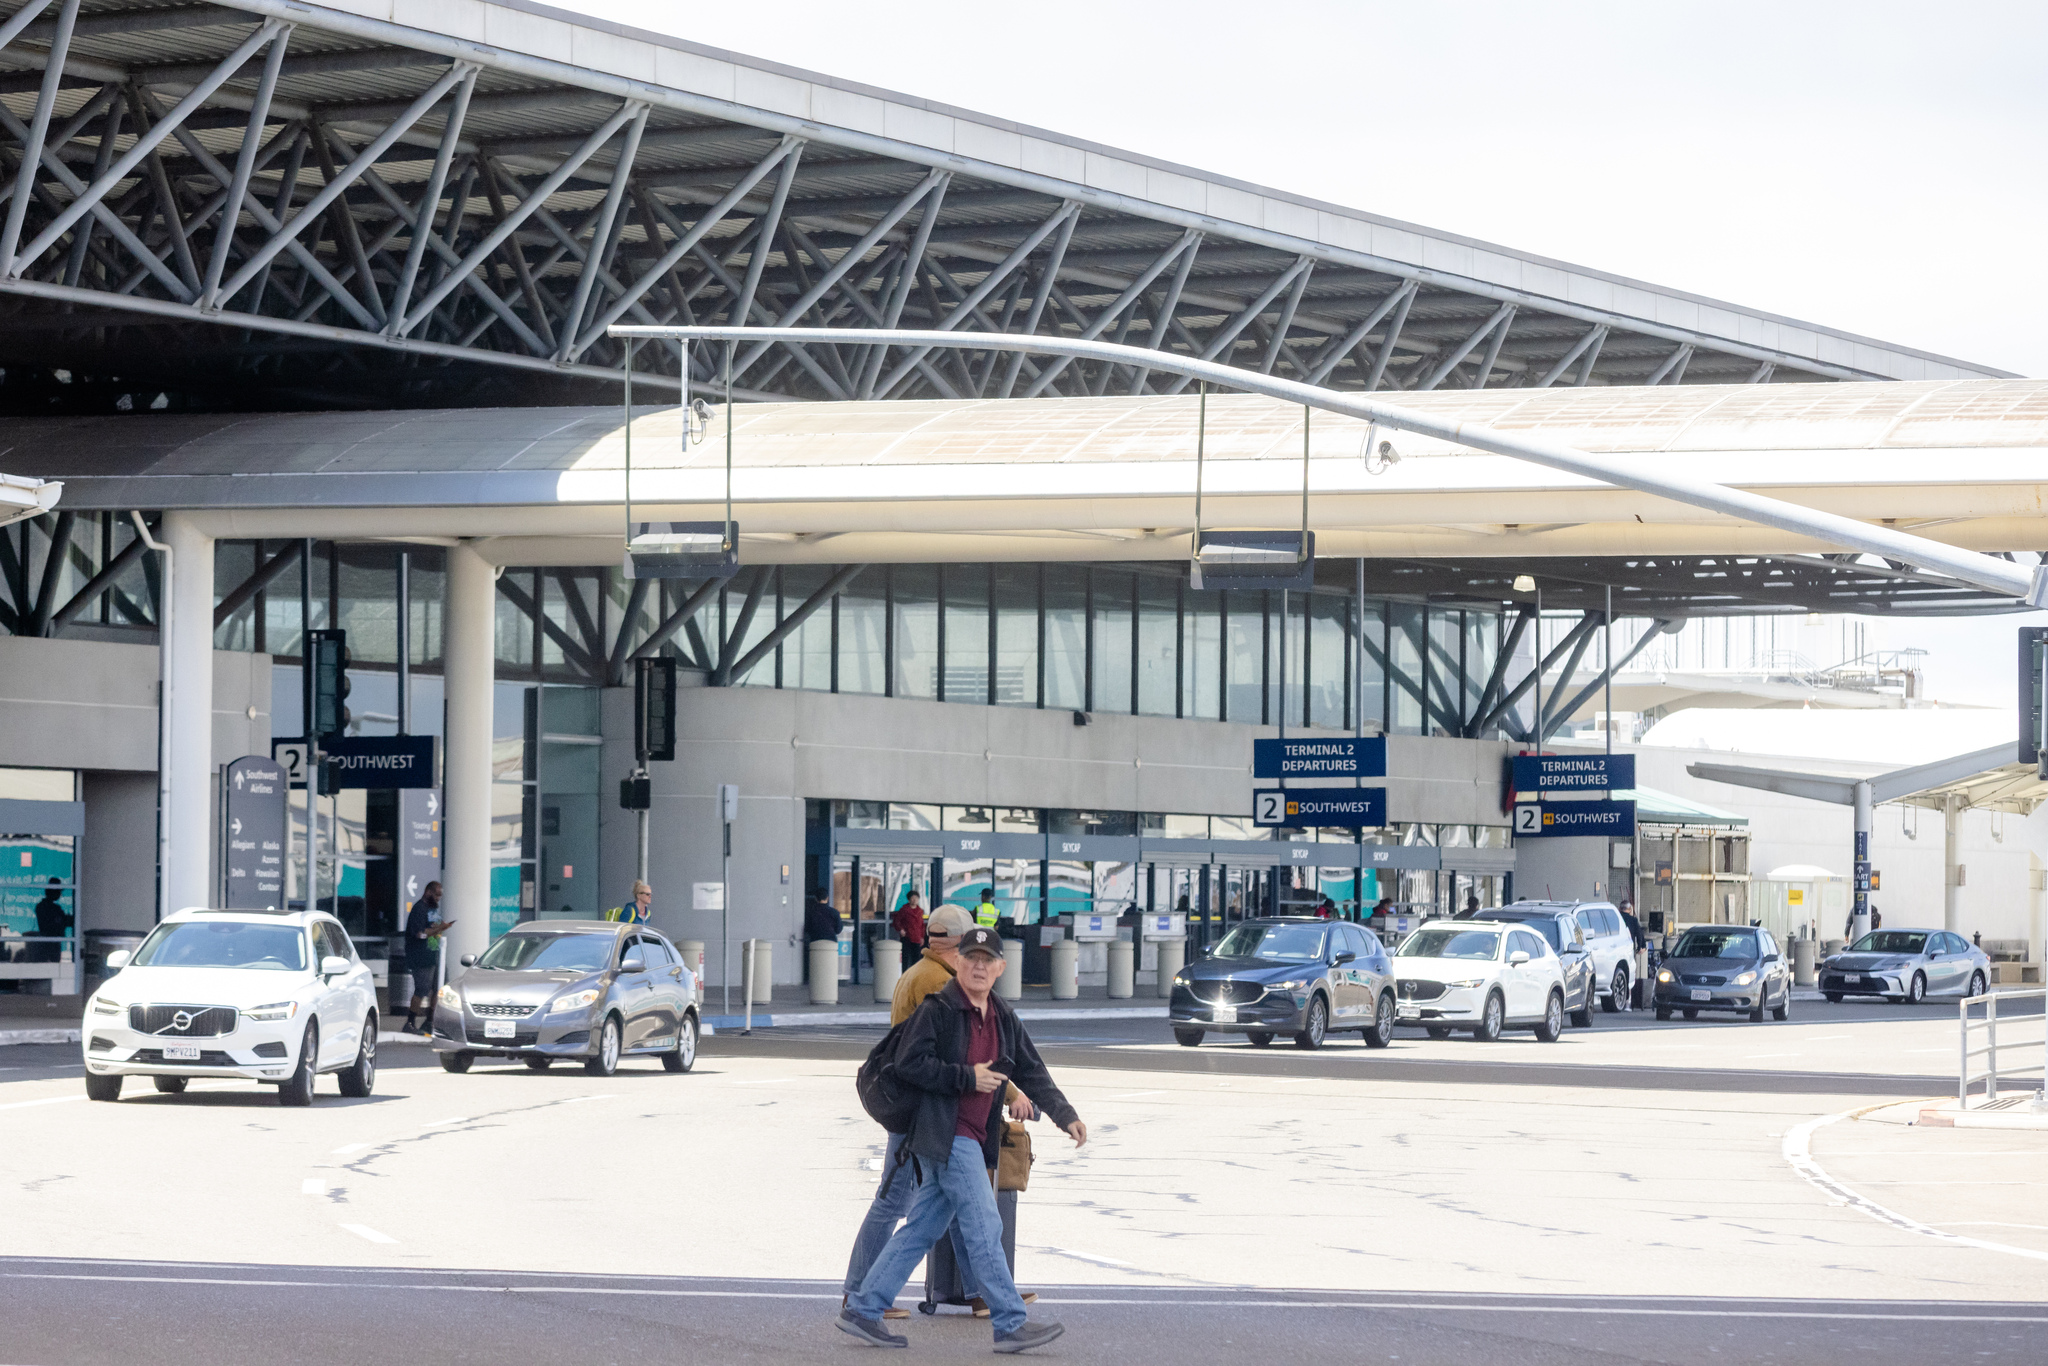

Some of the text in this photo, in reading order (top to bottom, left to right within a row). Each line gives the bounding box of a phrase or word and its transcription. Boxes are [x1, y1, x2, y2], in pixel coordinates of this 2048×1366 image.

[1284, 744, 1355, 756] TERMINAL 2
[285, 749, 300, 777] 2
[1282, 760, 1357, 771] DEPARTURES
[1541, 760, 1606, 772] TERMINAL 2
[245, 769, 278, 780] Southwest
[1540, 774, 1608, 786] DEPARTURES
[250, 783, 273, 794] Airlines
[1263, 797, 1278, 819] 2
[1299, 802, 1371, 813] SOUTHWEST
[1522, 809, 1536, 829] 2
[1555, 812, 1621, 824] SOUTHWEST
[231, 840, 256, 851] Allegiant
[262, 840, 280, 850] Alaska
[960, 839, 981, 851] SKYCAP
[1062, 842, 1081, 853] SKYCAP
[231, 868, 246, 877] Delta
[255, 868, 280, 878] Hawaiian
